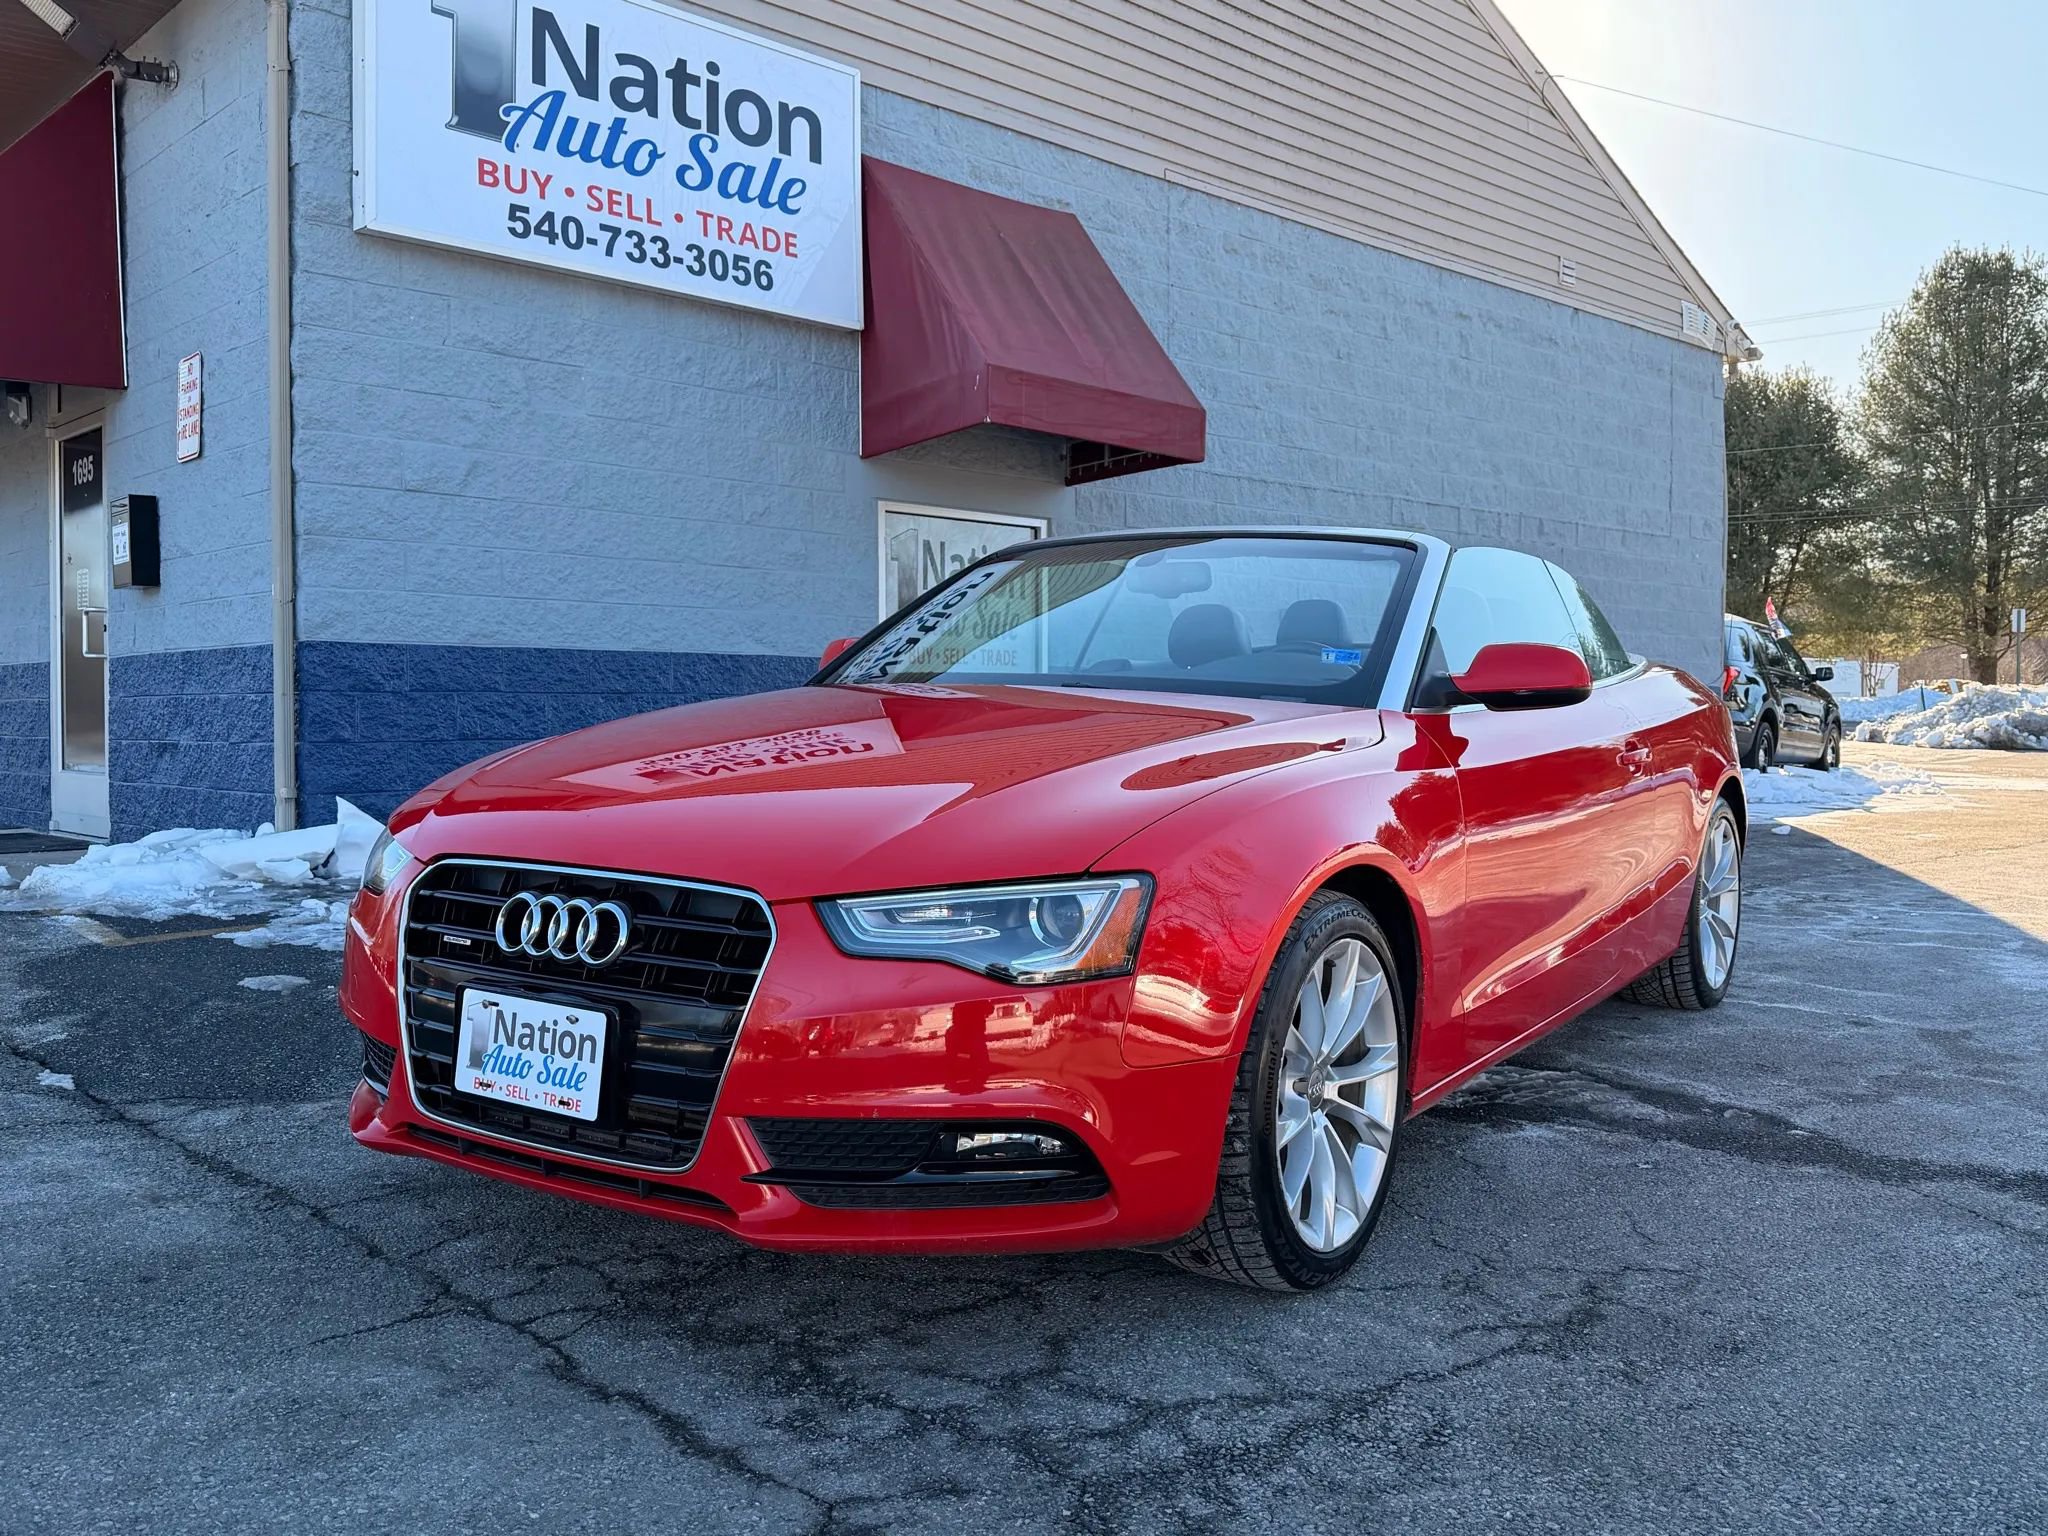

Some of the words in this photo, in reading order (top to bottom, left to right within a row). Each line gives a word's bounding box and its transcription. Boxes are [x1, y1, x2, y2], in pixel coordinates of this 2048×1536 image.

[431, 0, 517, 142] 1
[531, 7, 823, 165] Nation
[499, 89, 666, 178] Auto
[675, 133, 808, 216] Sale
[477, 157, 554, 200] BUY
[586, 184, 663, 228] SELL
[696, 209, 799, 260] TRADE
[507, 203, 775, 292] 540-733-3056
[72, 455, 94, 486] 1695
[981, 649, 1017, 667] TRADE
[493, 1009, 598, 1064] Nation
[482, 1044, 535, 1081] Auto
[537, 1055, 588, 1093] Sale
[505, 1084, 531, 1102] SELL
[543, 1092, 582, 1114] TRADE
